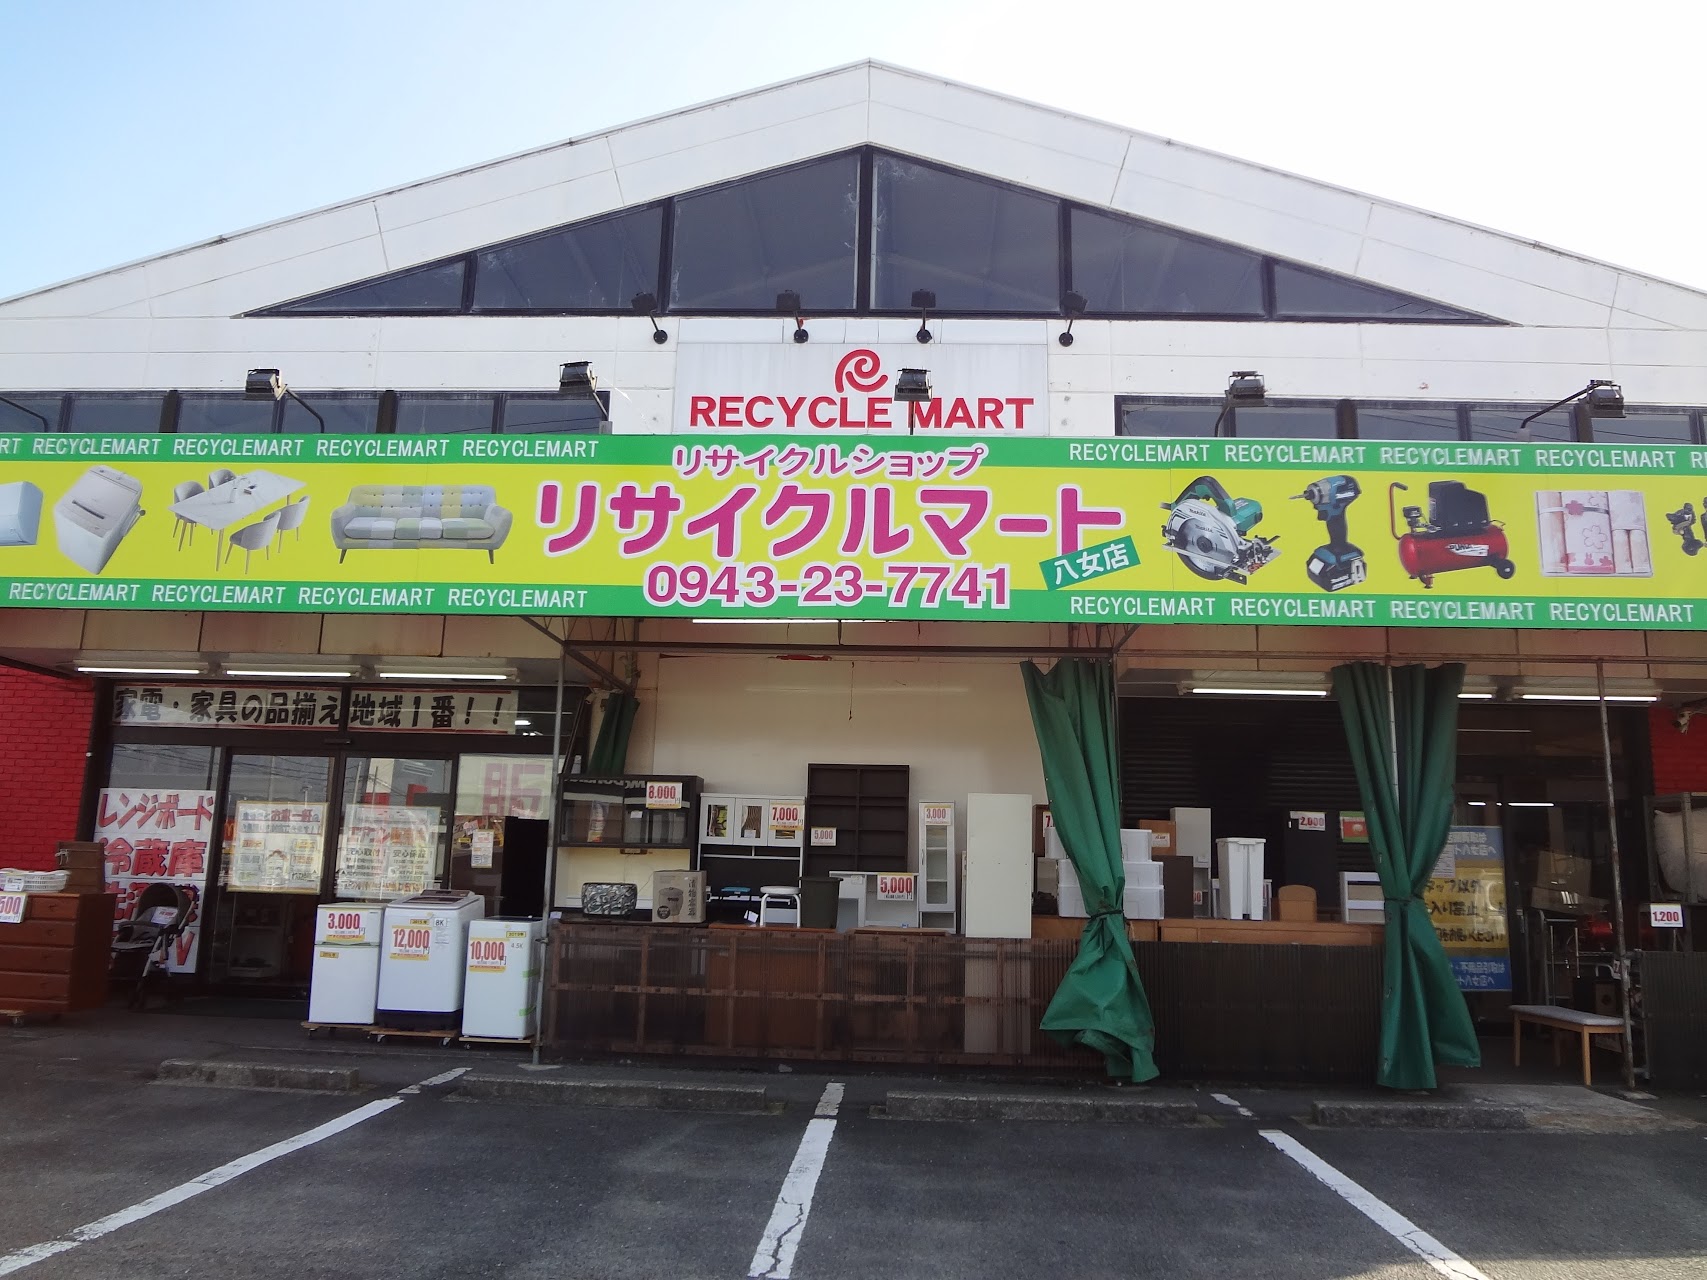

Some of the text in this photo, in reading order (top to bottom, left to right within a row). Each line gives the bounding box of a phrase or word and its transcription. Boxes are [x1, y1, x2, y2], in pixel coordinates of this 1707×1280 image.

[690, 396, 1034, 429] RECYCLE MART
[33, 438, 162, 454] RECYCLEMART
[173, 439, 304, 456] RECYCLEMART
[316, 439, 449, 457] RECYCLEMART
[462, 440, 598, 458] RECYCLEMART
[1069, 443, 1210, 462] RECYCLEMART
[1225, 445, 1366, 465] RECYCLEMART
[1380, 447, 1521, 467] RECYCLEMART
[1535, 449, 1677, 469] RECYCLEMART
[675, 446, 982, 478] リサイクルショップ
[539, 482, 1123, 559] リサイクルマート
[1054, 543, 1130, 585] 八女店
[9, 582, 588, 608] RECYCLEMART RECYCLEMART RECYCLEMART RECYCLEMART
[645, 563, 1008, 606] 0943-23-7741
[1070, 596, 1694, 623] RECYCLEMART RECYCLEMART RECYCLEMART RECYCLEMART
[97, 792, 214, 831] レンジボード
[772, 806, 798, 822] 7,000
[99, 836, 208, 878] 冷蔵庫
[880, 876, 913, 895] 5,000
[1652, 911, 1680, 923] 1,200
[393, 928, 430, 950] 12,000
[470, 940, 505, 962] 10,000
